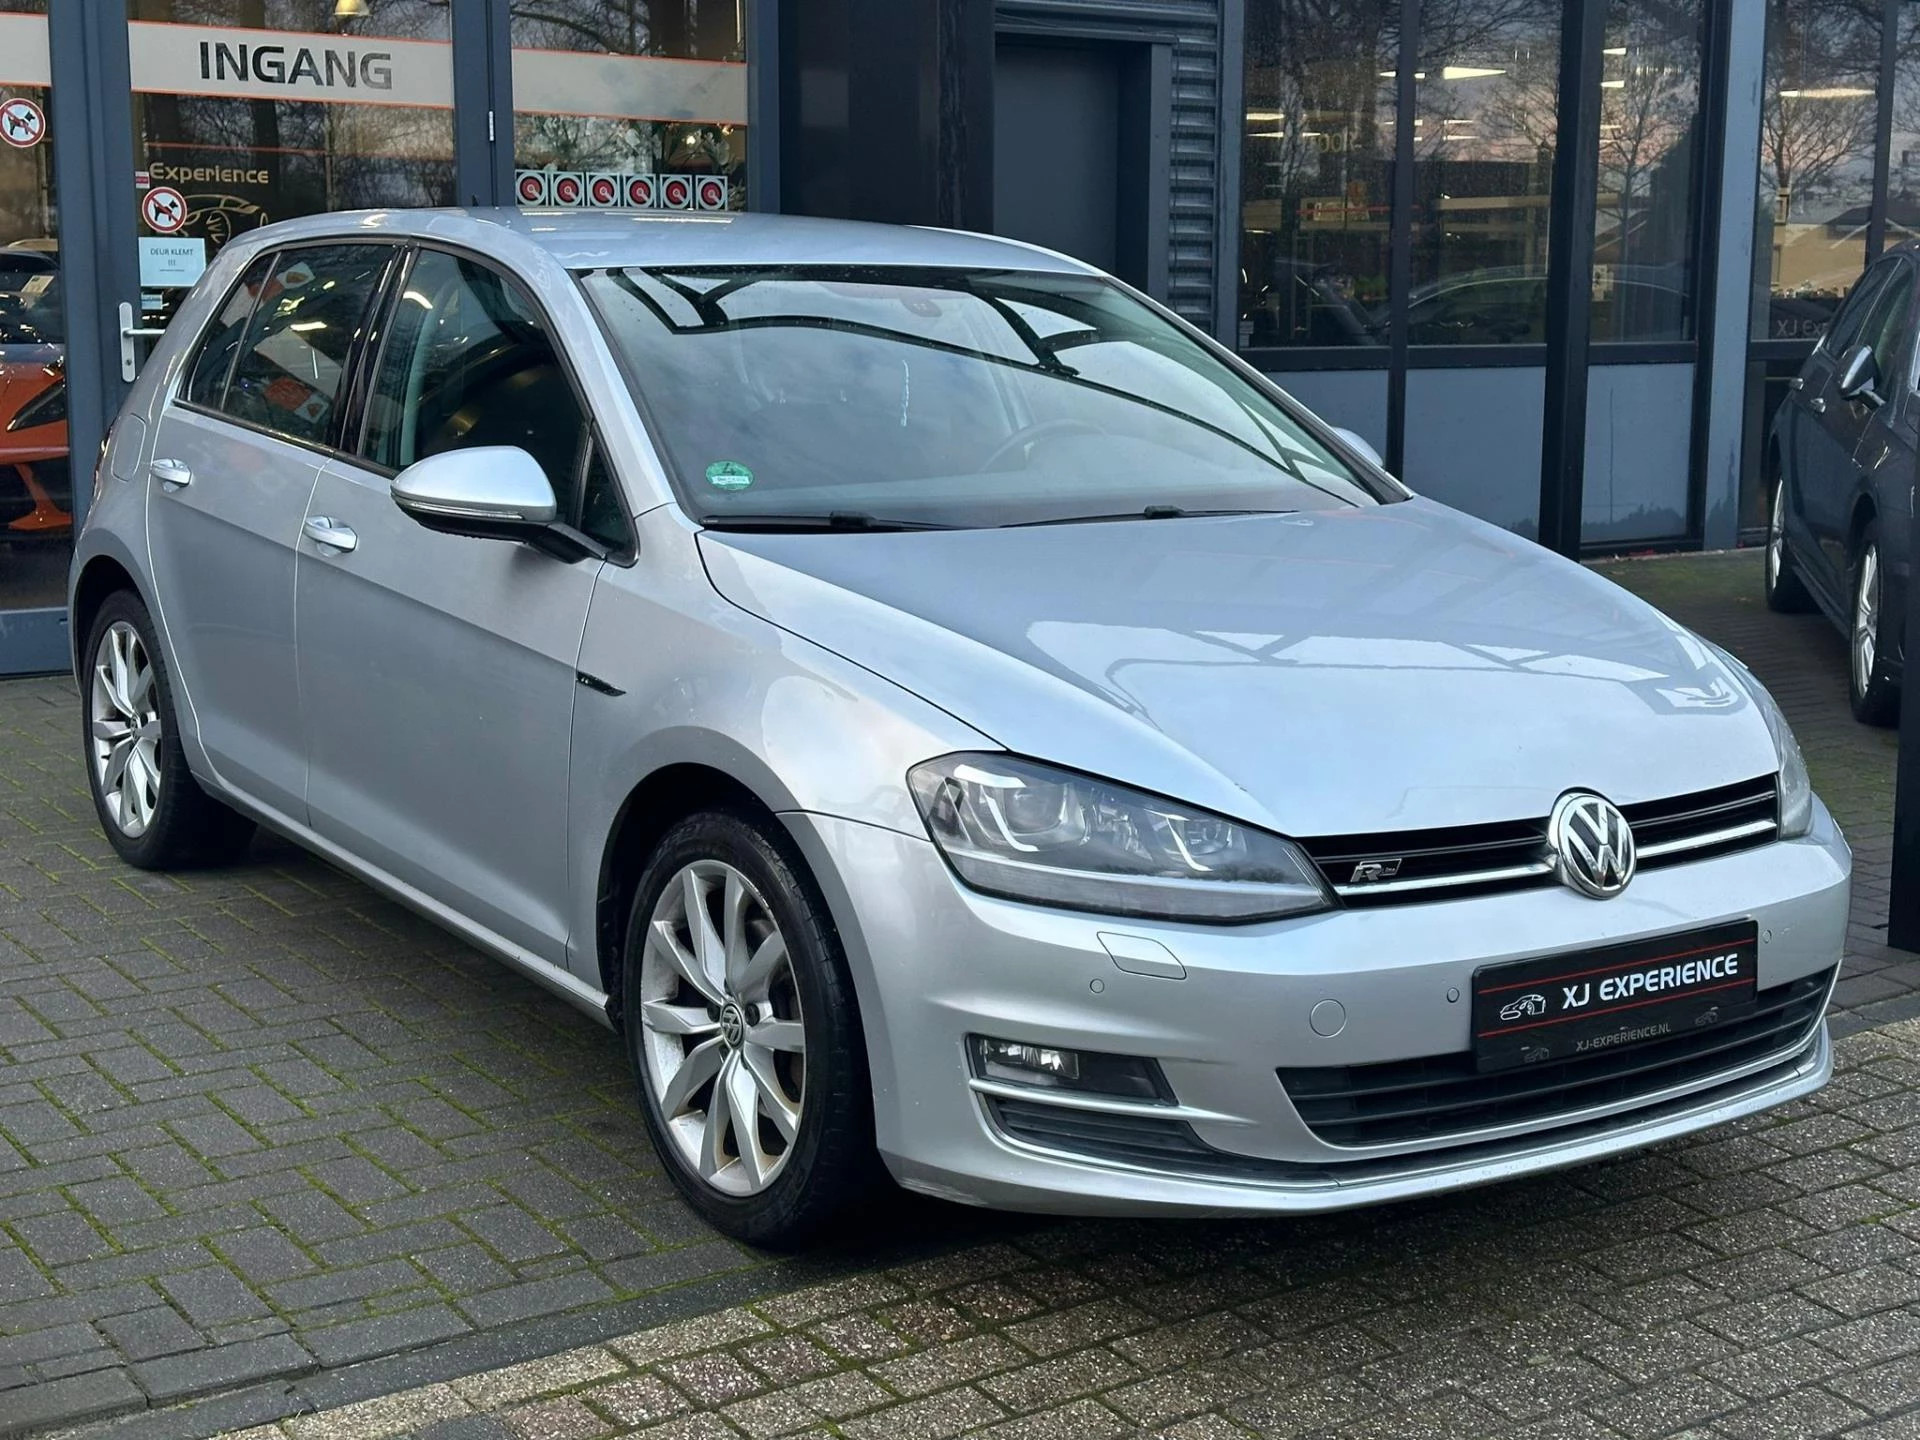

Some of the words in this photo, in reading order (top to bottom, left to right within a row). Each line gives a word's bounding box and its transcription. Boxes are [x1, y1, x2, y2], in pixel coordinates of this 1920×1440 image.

[200, 42, 392, 90] INGANG
[150, 162, 269, 184] Experience
[150, 248, 169, 256] DEUR
[171, 248, 194, 256] KLEMT
[1776, 319, 1798, 337] XJ
[1562, 983, 1590, 1010] XJ
[1600, 953, 1738, 1001] EXPERIENCE
[1576, 1023, 1672, 1052] XJ-EXPERIENCE.NL
